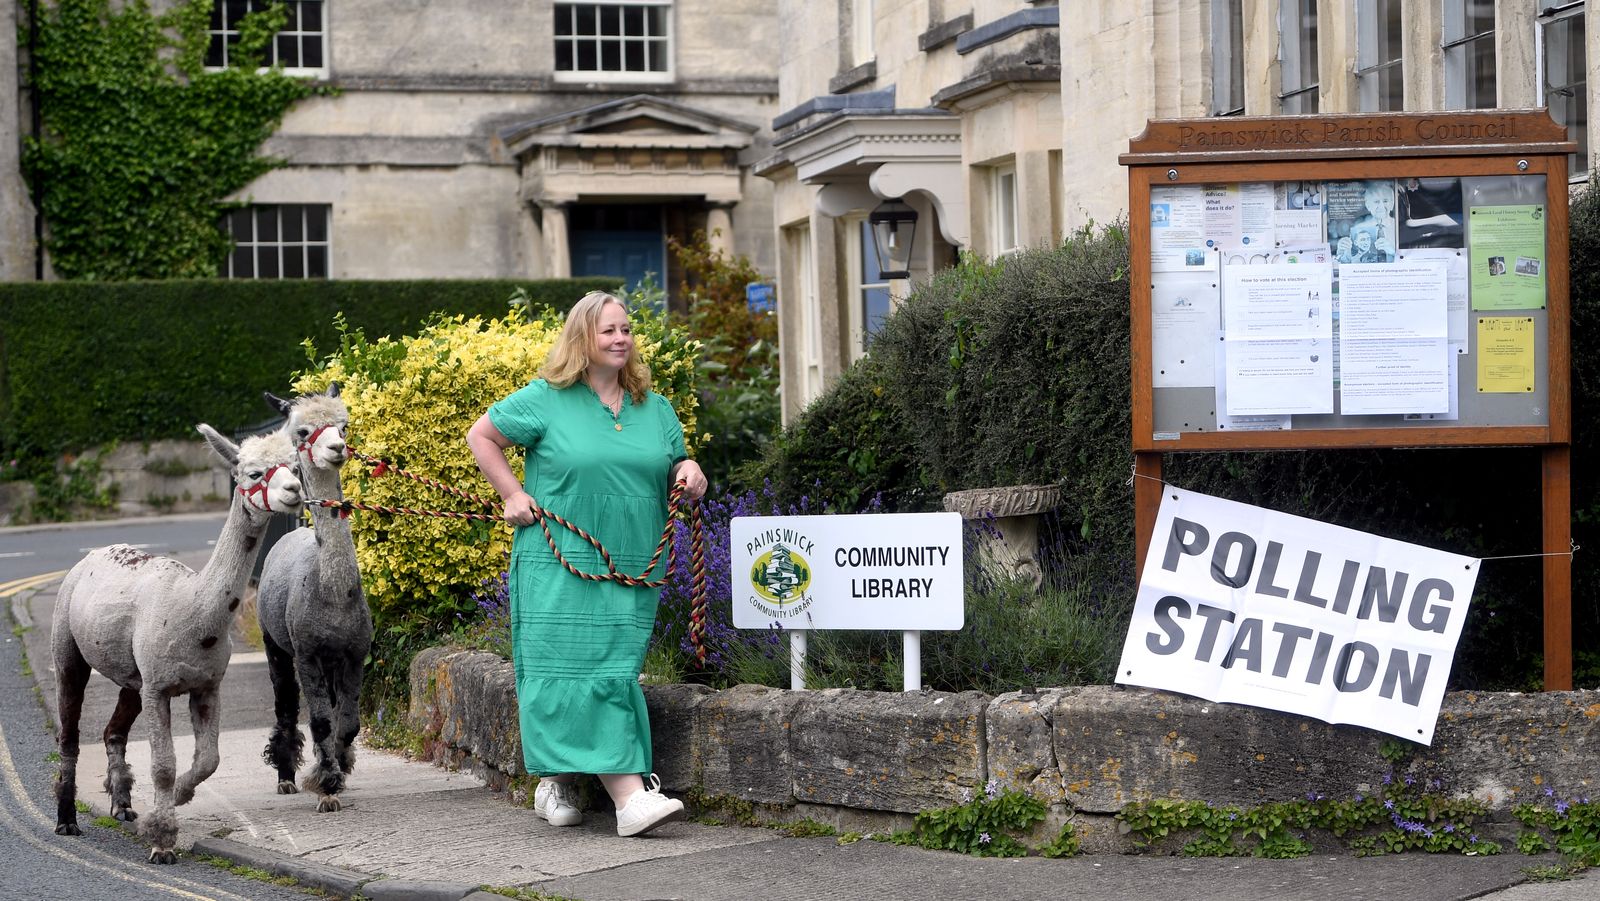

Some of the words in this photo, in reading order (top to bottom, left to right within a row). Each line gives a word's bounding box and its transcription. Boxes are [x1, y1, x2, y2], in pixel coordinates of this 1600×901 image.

[1178, 123, 1310, 147] Painswick
[1321, 120, 1403, 143] Parish
[1415, 117, 1518, 141] Council
[746, 528, 815, 556] PAINSWICK
[834, 546, 950, 568] COMMUNITY
[851, 578, 934, 598] LIBRARY
[1161, 516, 1455, 634] POLLING
[749, 595, 787, 618] COMMUNITY
[788, 595, 814, 618] LIBRARY
[1145, 595, 1432, 707] STATION
